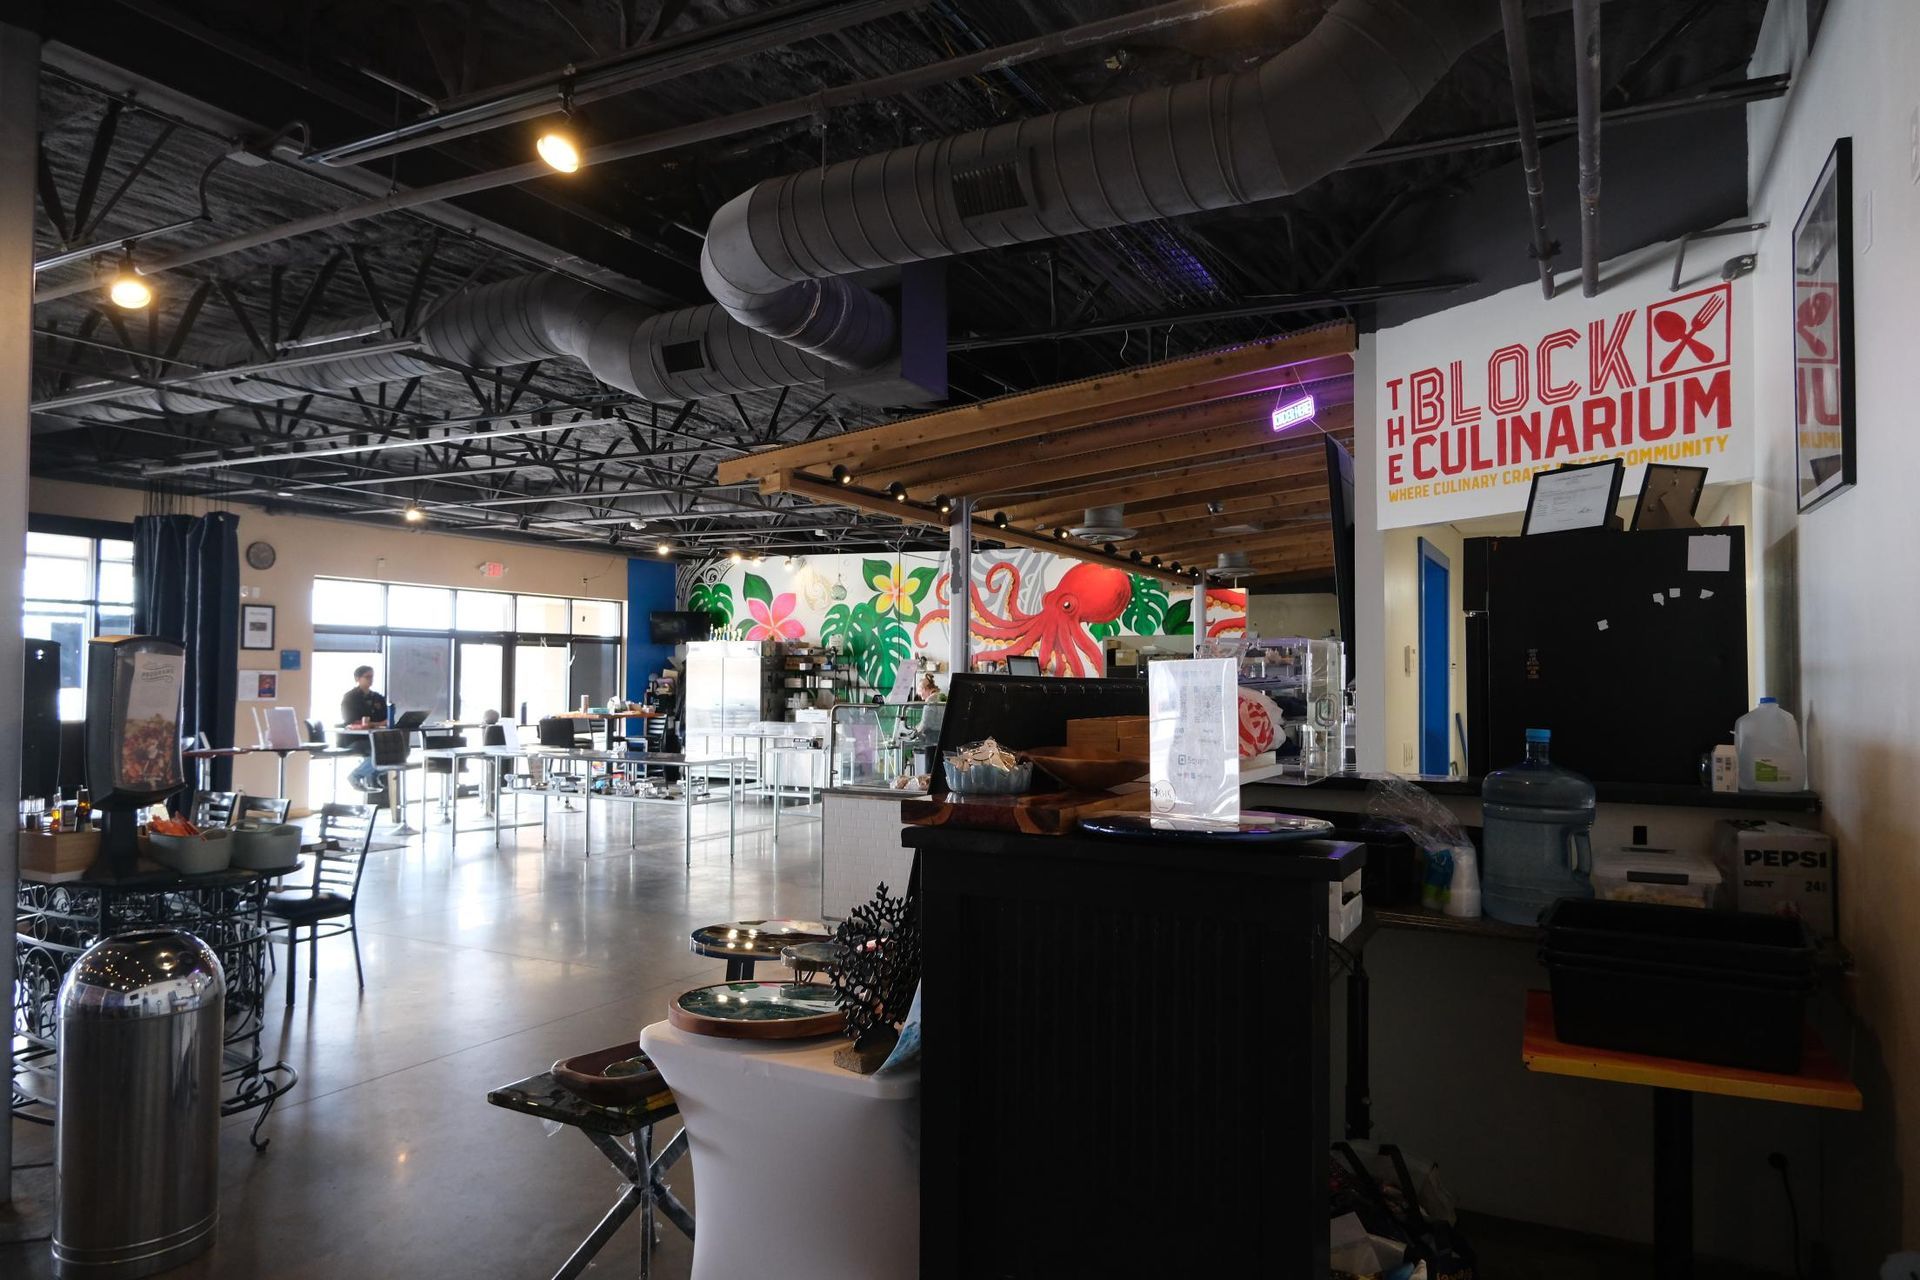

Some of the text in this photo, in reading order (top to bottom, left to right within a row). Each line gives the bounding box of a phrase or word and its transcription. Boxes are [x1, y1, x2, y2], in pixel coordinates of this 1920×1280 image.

[1410, 309, 1637, 434] BLOCK
[1386, 378, 1404, 485] THE
[1412, 370, 1732, 481] CULINARIUM
[1388, 484, 1430, 503] WHERE
[1433, 473, 1498, 496] CULINARY
[1503, 463, 1551, 485] CRAFT
[1743, 849, 1827, 868] PEPSI
